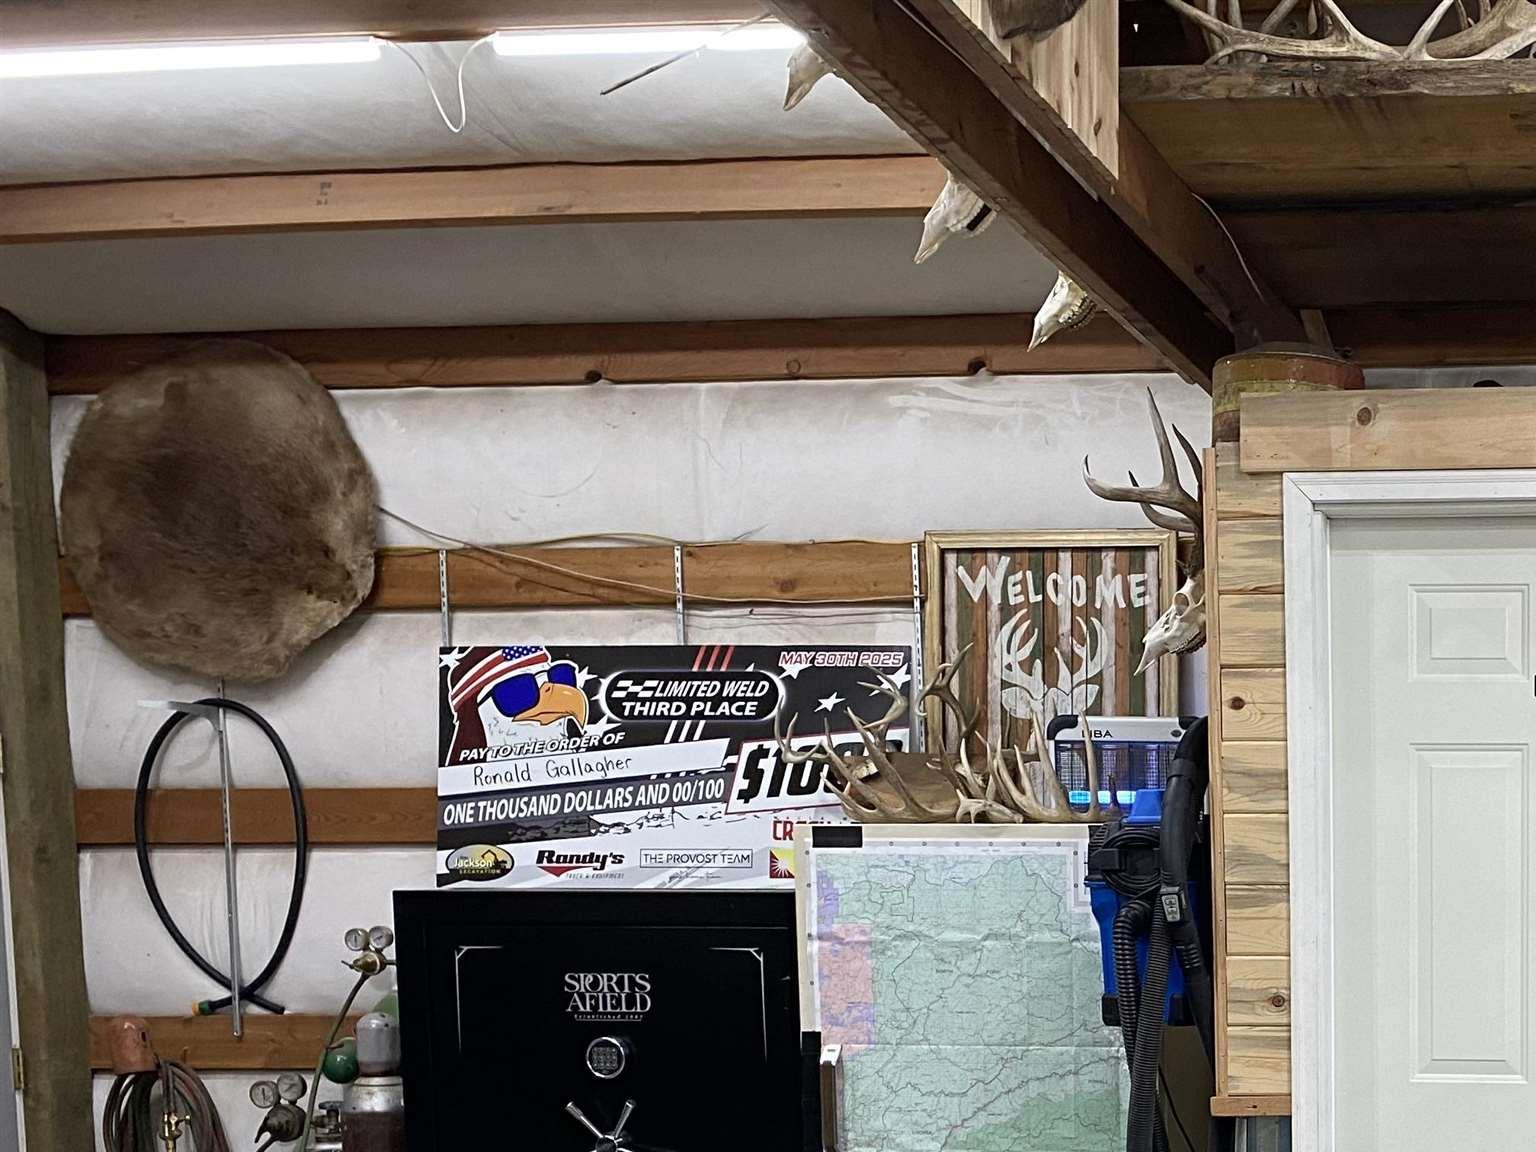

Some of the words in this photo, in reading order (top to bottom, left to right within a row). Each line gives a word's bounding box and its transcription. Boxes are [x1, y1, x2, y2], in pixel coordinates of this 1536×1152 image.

[957, 556, 1150, 610] WELCOME
[778, 651, 814, 667] MAY
[814, 651, 858, 667] 30TH
[859, 652, 904, 667] 2025
[655, 680, 719, 697] LIMITED
[721, 680, 769, 697] WELD
[622, 702, 687, 716] THIRD
[691, 701, 757, 716] PLACE
[459, 748, 488, 761] PAY
[488, 746, 509, 758] TO
[509, 743, 545, 756] THE
[546, 735, 600, 752] ORDER
[602, 732, 625, 744] OF
[473, 764, 531, 786] Ronald
[546, 756, 633, 780] Gallagher
[443, 802, 475, 826] ONE
[478, 794, 559, 822] THOUSAND
[563, 785, 633, 813] DOLLARS
[635, 780, 669, 807] AND
[672, 777, 726, 802] 00/100
[453, 858, 493, 869] Jackson
[535, 850, 625, 871] Randy's
[643, 853, 664, 864] THE
[666, 853, 719, 864] PROVOST
[721, 852, 750, 864] TEAM
[564, 972, 652, 993] SPORTS
[565, 993, 652, 1013] AFIELD
